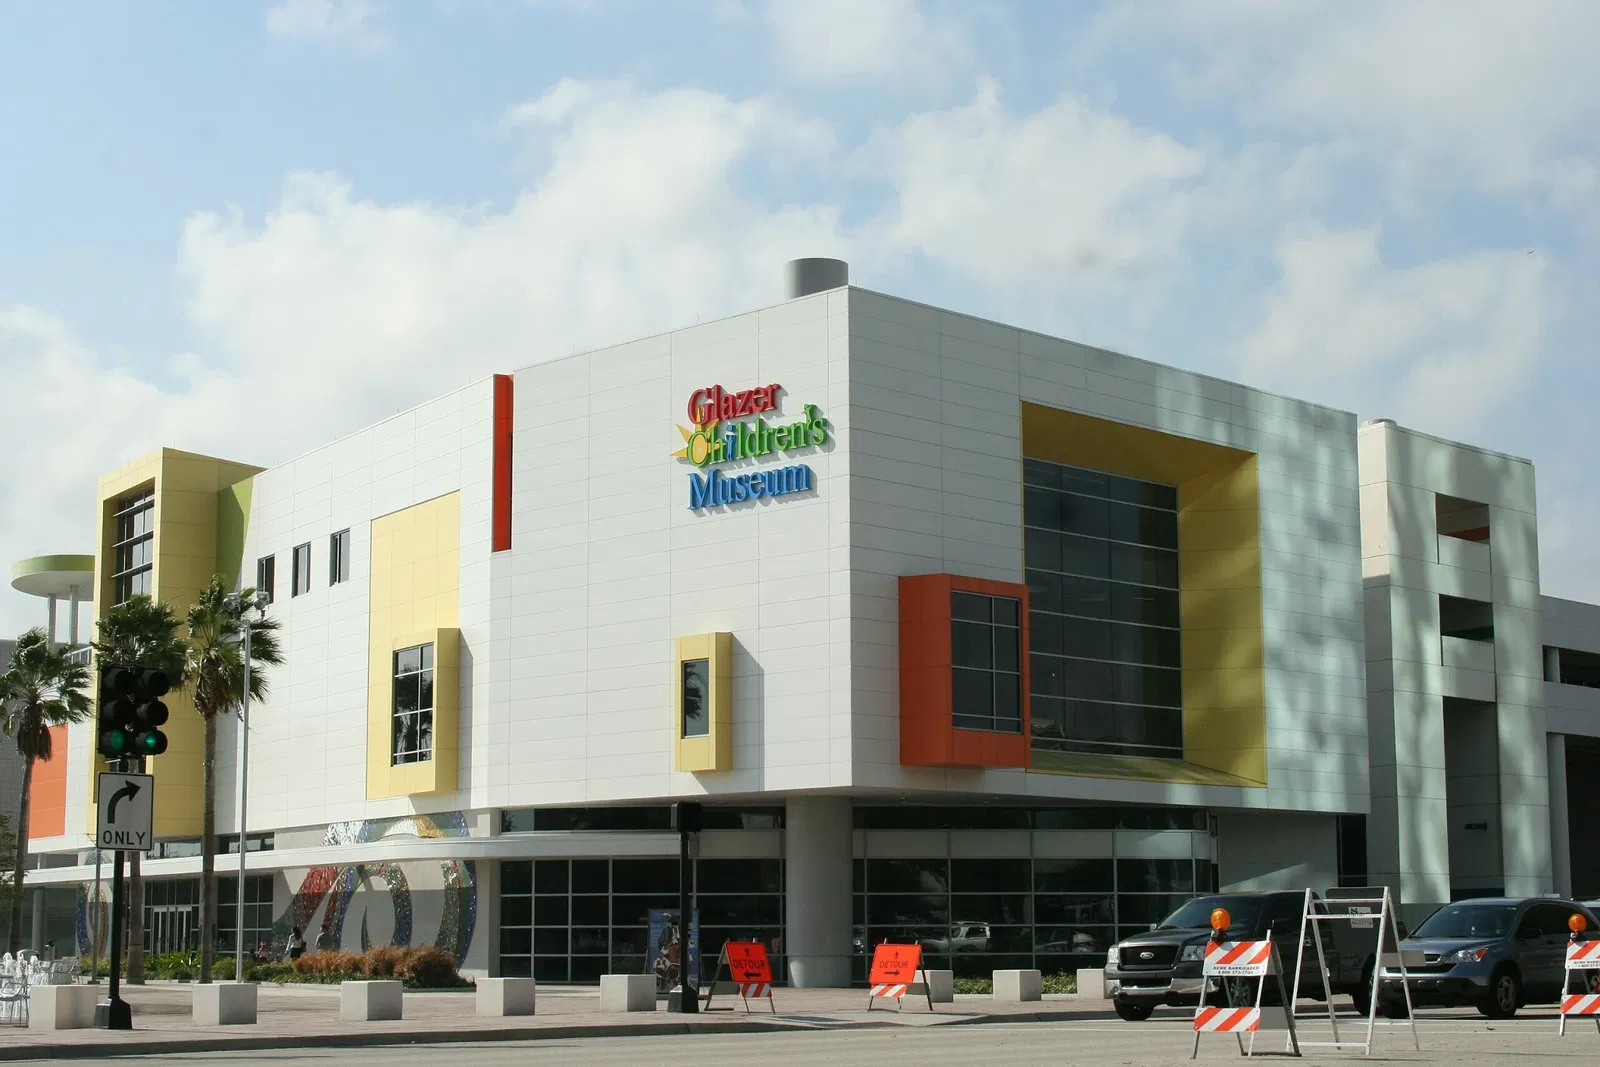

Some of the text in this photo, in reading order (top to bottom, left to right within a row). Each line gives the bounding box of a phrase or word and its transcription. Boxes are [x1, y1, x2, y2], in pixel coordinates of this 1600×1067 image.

[688, 383, 781, 425] Glazer
[687, 404, 827, 467] Children's
[687, 464, 812, 510] Museum
[103, 830, 146, 846] ONLY
[732, 959, 766, 969] DETOUR
[879, 960, 909, 969] DETOUR
